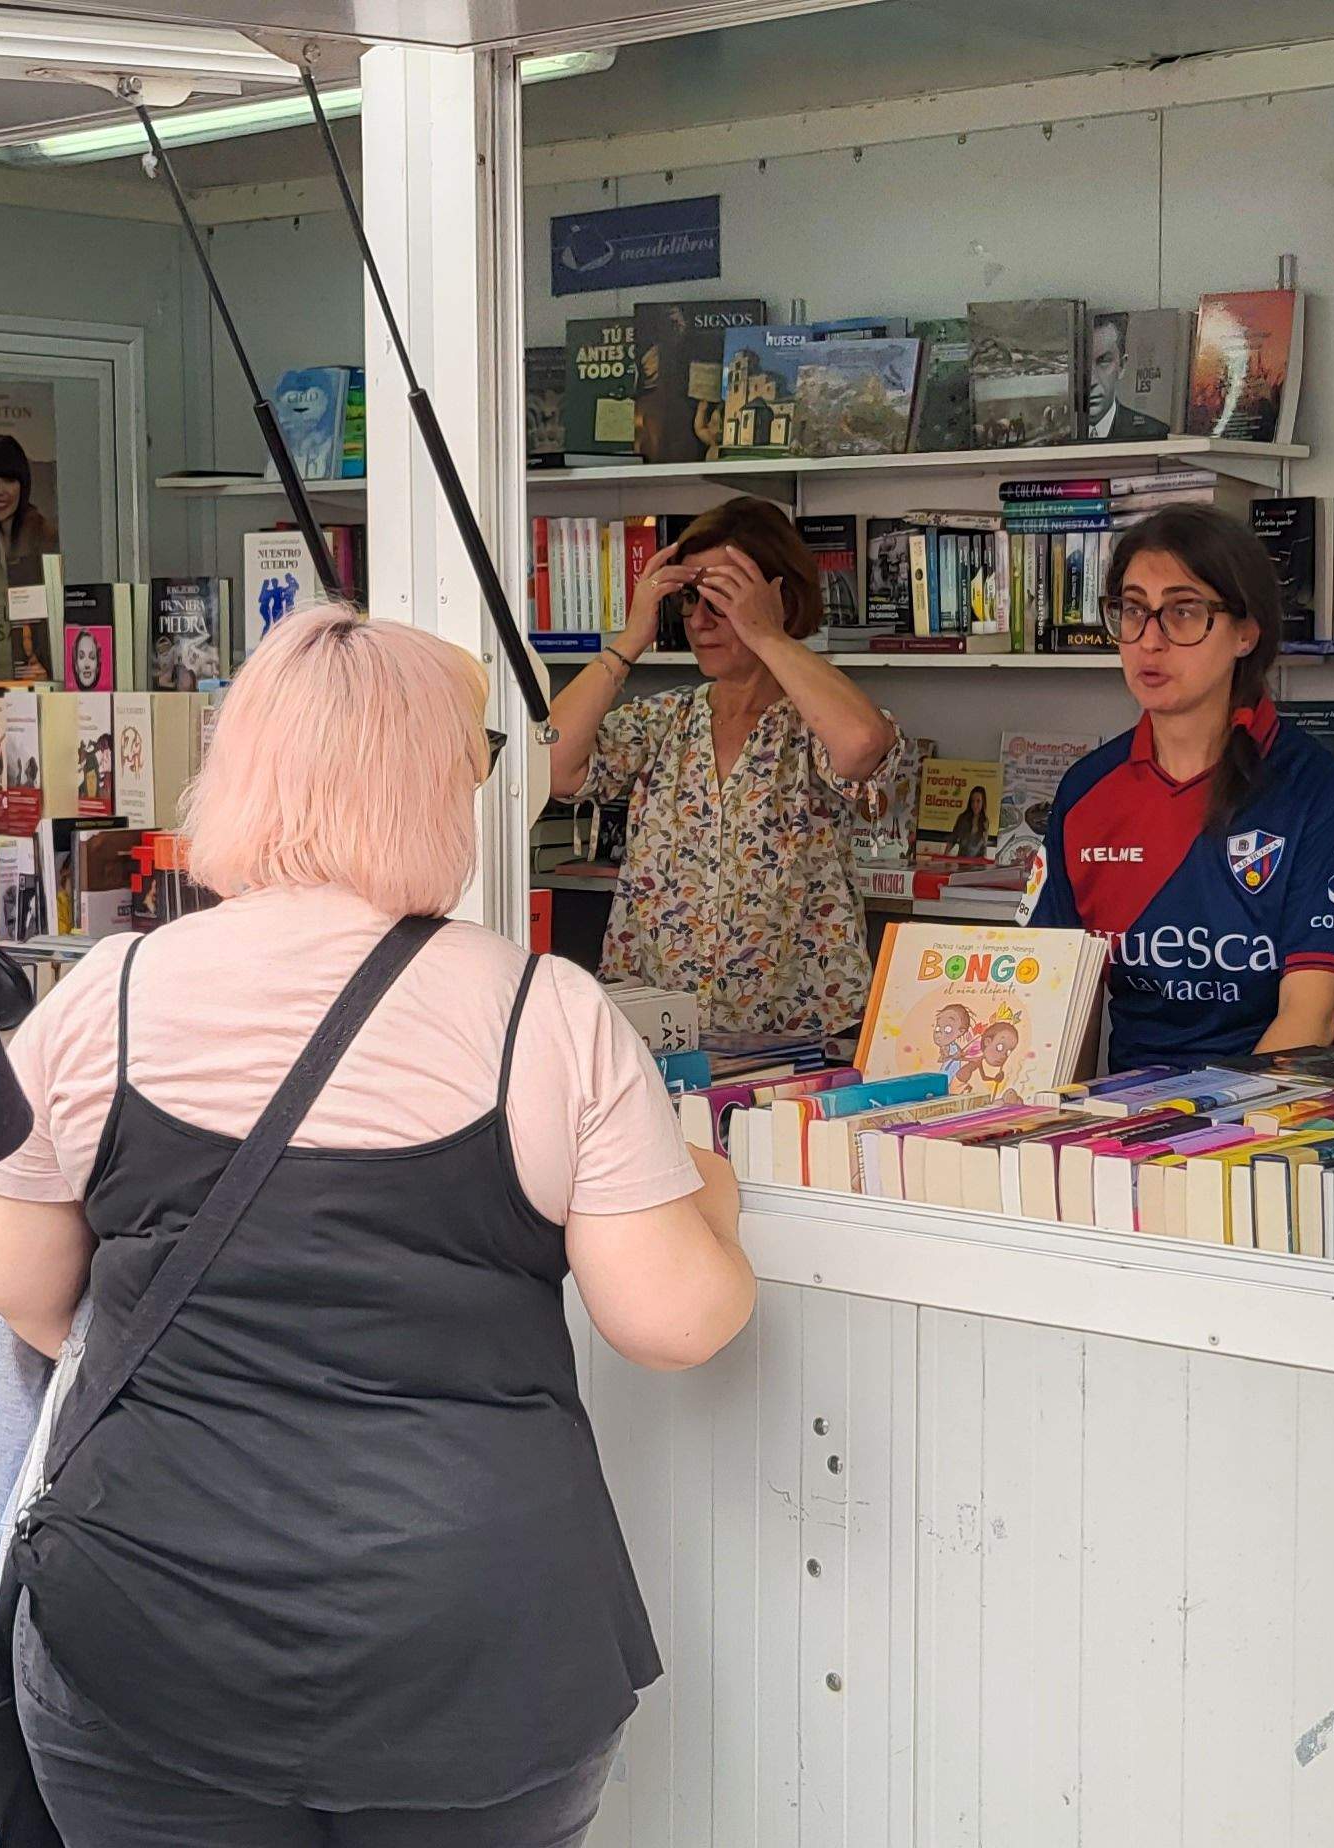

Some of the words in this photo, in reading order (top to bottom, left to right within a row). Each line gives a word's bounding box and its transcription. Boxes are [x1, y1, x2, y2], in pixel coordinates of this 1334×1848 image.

[694, 312, 754, 329] SIGNOS
[576, 346, 625, 363] ANTES
[577, 361, 624, 380] TODO
[1068, 635, 1104, 645] ROMA
[1080, 847, 1144, 862] KELME
[917, 949, 1040, 985] BONGO
